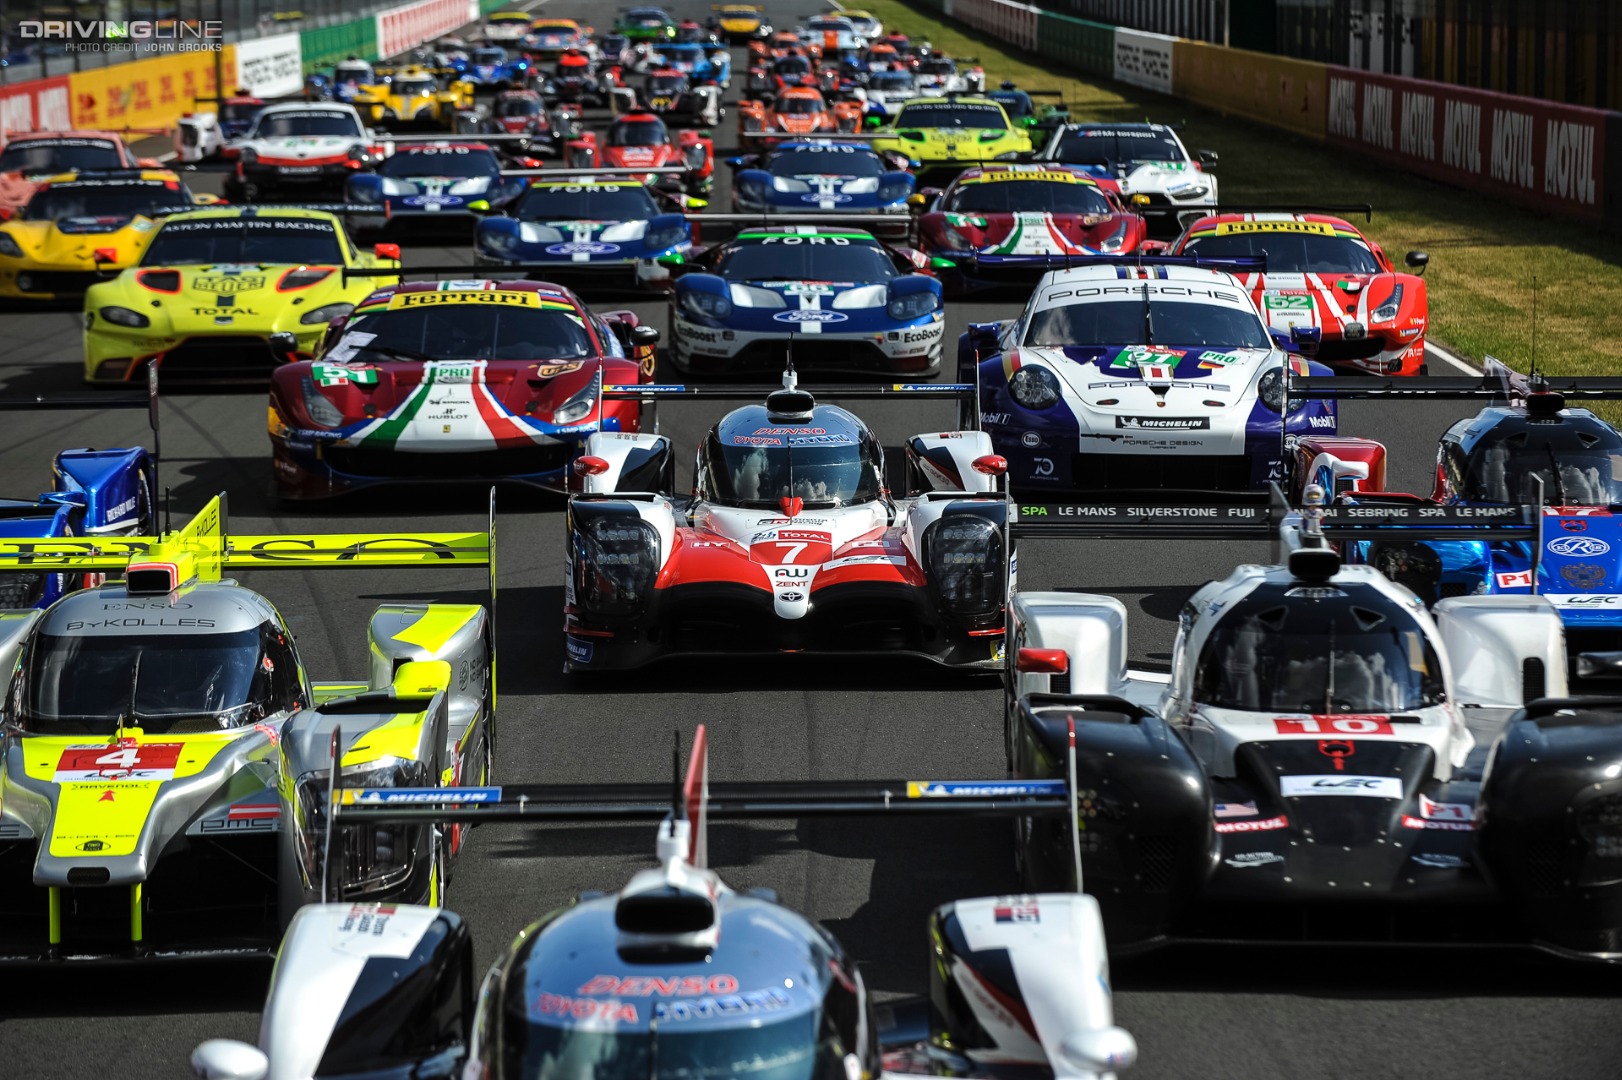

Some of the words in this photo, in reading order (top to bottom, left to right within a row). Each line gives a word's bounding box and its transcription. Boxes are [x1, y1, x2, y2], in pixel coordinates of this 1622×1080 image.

[1363, 82, 1393, 150] MOTUL
[1400, 91, 1435, 161] MOTUL
[1443, 99, 1482, 175] MOTUL
[1491, 109, 1534, 189] MOTUL
[1544, 119, 1596, 205] MOTUL
[550, 184, 620, 193] FORD
[214, 221, 272, 230] MARTIN
[274, 222, 334, 233] RACING
[1226, 223, 1326, 234] Ferrari
[762, 236, 851, 246] FORD
[400, 290, 529, 308] Ferrari
[1048, 286, 1240, 303] PORSCHE
[1268, 295, 1308, 309] 52
[192, 308, 260, 316] TOTAL
[1125, 351, 1172, 368] 91
[1204, 352, 1238, 363] PRO
[323, 366, 369, 384] 51
[440, 367, 471, 377] PRO
[752, 427, 826, 435] DENSO
[733, 436, 782, 445] TOYOTA
[1022, 506, 1048, 516] SPA
[1058, 506, 1074, 516] LE
[1077, 506, 1117, 516] MANS
[1127, 507, 1218, 518] SILVERSTONE
[1228, 508, 1255, 518] FUJI
[1348, 508, 1409, 518] SEBRING
[1419, 507, 1446, 518] SPA
[1456, 507, 1473, 517] LE
[1475, 507, 1517, 517] MANS
[781, 532, 830, 541] TOTAL
[775, 542, 809, 564] 7
[1501, 573, 1532, 586] P1
[1567, 595, 1619, 604] WEC
[103, 602, 193, 611] ENSO
[1286, 719, 1380, 733] 10
[95, 748, 141, 768] 4
[1312, 778, 1383, 789] WEC
[386, 793, 488, 802] MICHELIN
[1214, 817, 1285, 833] MOTUL
[577, 974, 740, 997] DENSO
[533, 991, 640, 1024] TOYOTA
